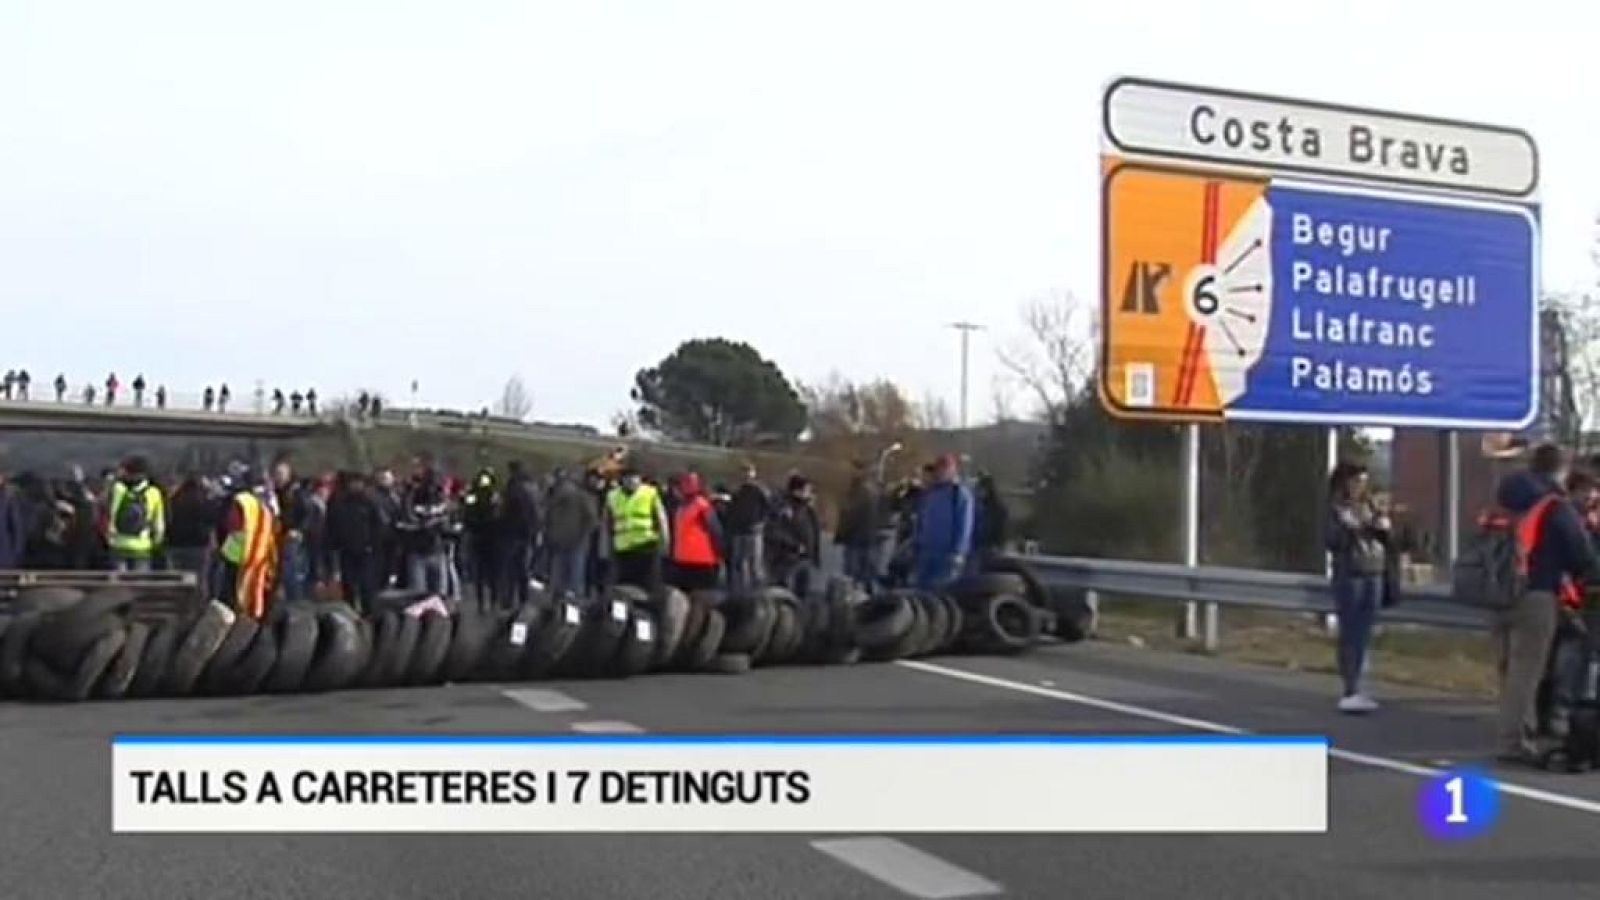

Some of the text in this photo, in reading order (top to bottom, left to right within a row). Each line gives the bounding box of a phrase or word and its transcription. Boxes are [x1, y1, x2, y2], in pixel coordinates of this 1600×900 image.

[1191, 105, 1470, 174] Costa Brava
[1293, 214, 1391, 255] Begur
[1193, 275, 1219, 315] 6
[1293, 262, 1476, 308] Palafrugell
[1293, 309, 1434, 347] Llafranc
[1293, 357, 1432, 394] Palamós
